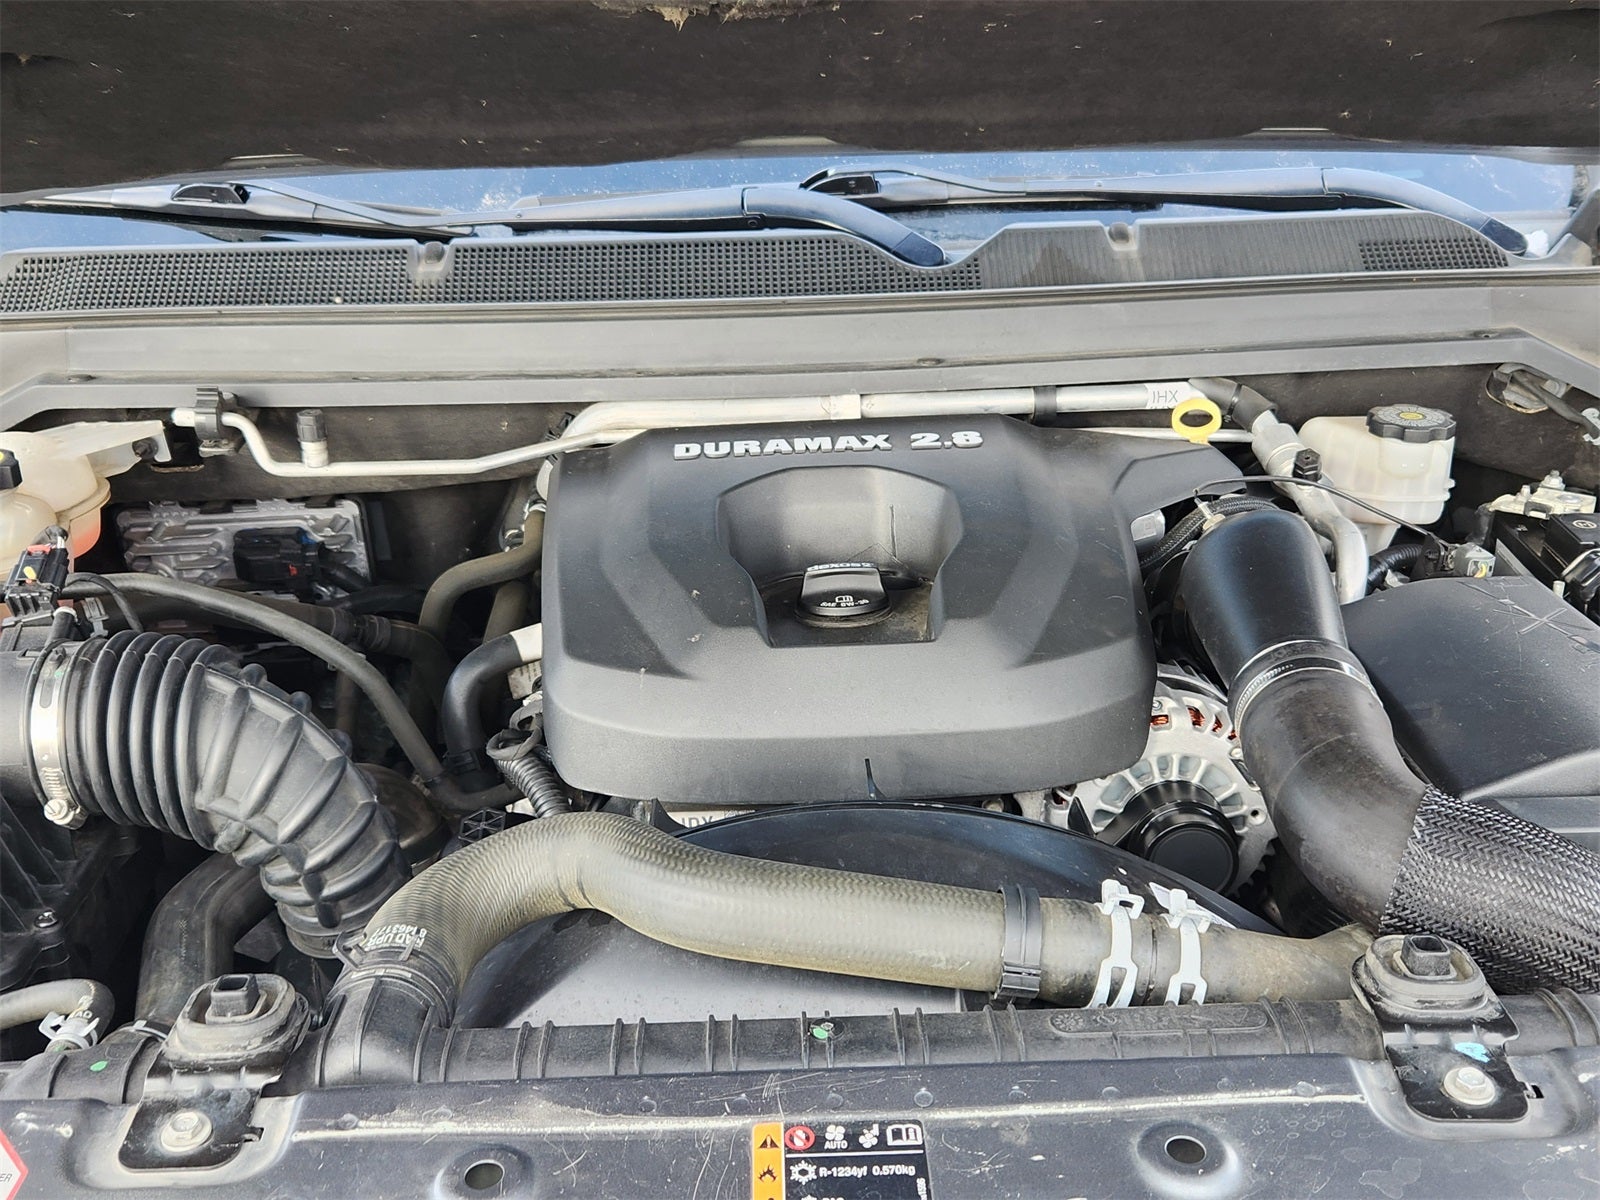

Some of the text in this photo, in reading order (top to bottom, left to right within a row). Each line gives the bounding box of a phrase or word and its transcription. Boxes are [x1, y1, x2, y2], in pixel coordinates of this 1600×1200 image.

[673, 430, 984, 460] DURAMAX 2.8
[824, 1140, 848, 1150] AUTO
[872, 1164, 916, 1176] 0.570kg
